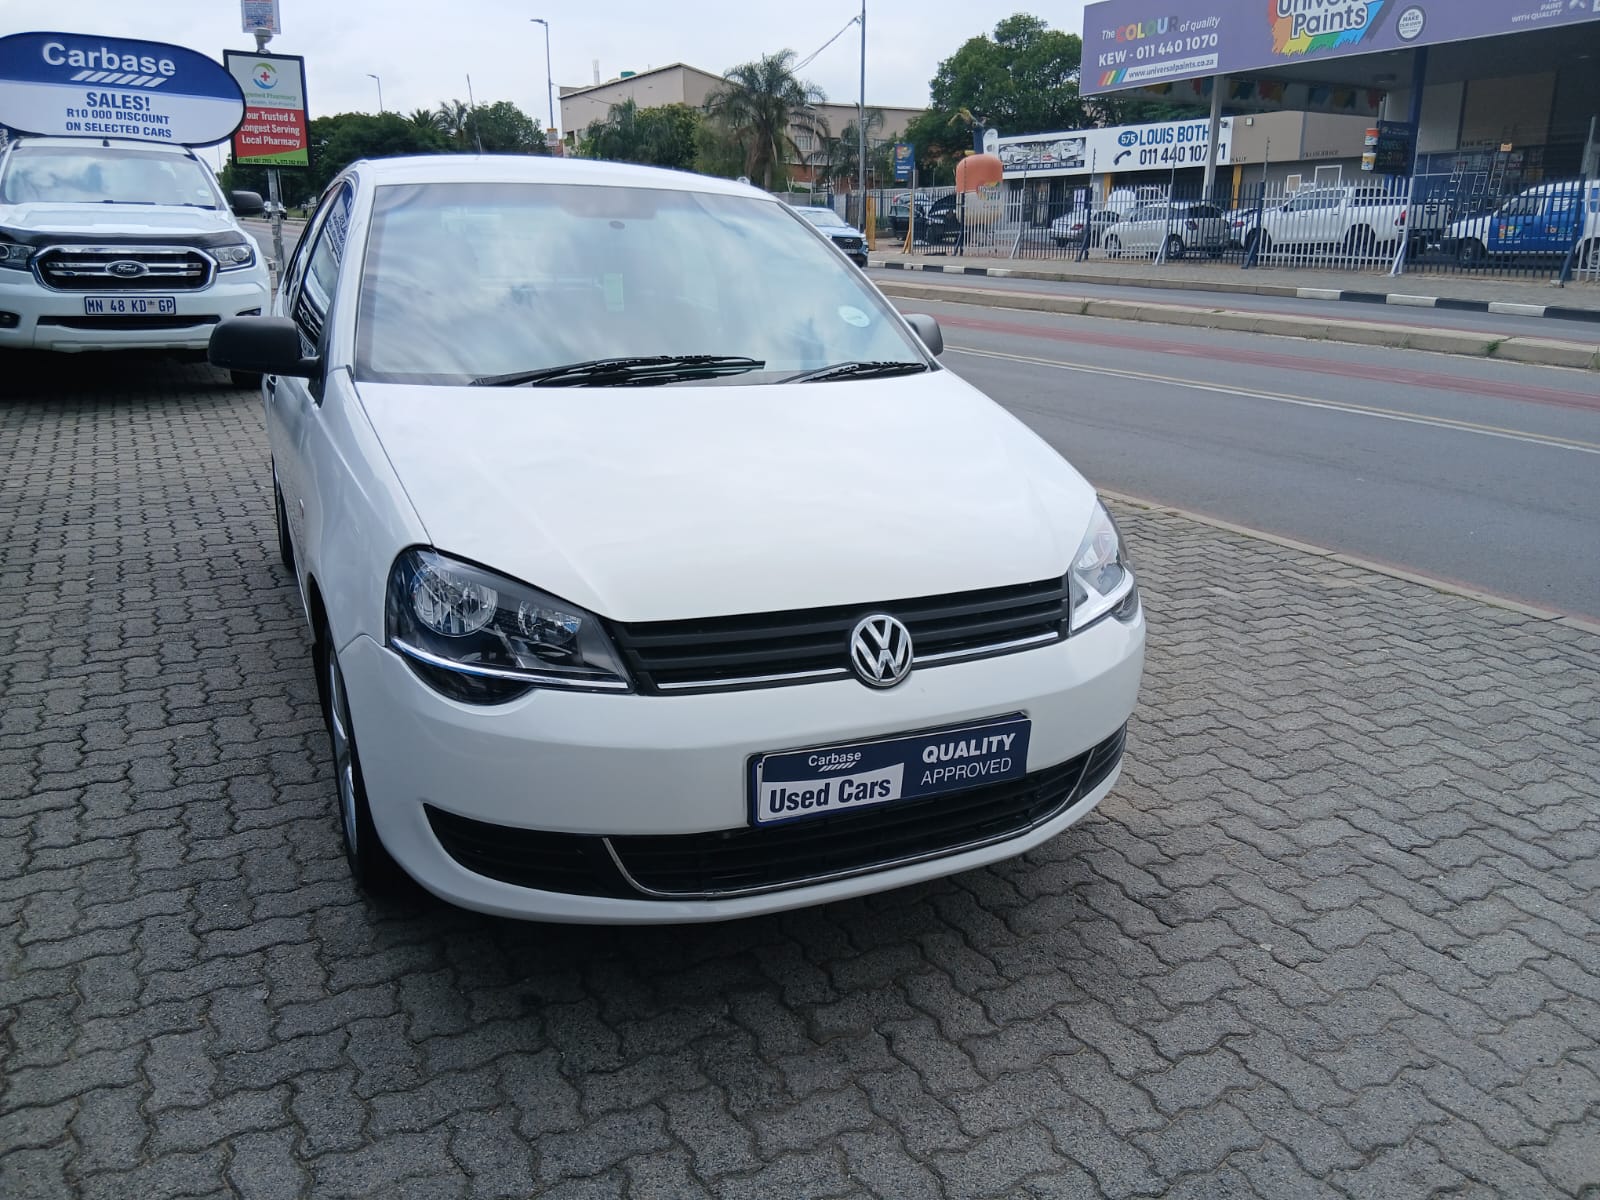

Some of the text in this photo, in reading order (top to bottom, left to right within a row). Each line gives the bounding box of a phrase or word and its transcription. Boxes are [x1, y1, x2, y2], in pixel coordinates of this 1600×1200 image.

[1293, 8, 1366, 36] Paints
[1511, 9, 1562, 22] WITH QUALITY
[1102, 16, 1220, 43] The COLOUR of quality
[42, 43, 176, 76] Carbase
[1098, 49, 1127, 67] KEW
[1136, 44, 1155, 60] 011
[1158, 40, 1183, 56] 440
[1186, 33, 1218, 50] 1070
[1128, 59, 1214, 78] www.universalpaints.co.za
[86, 92, 150, 111] SALES!
[67, 108, 170, 124] R10 000 DISCOUNT
[260, 112, 288, 121] Trusted
[290, 113, 296, 122] &
[66, 122, 172, 138] ON SELECTED CARS
[271, 125, 300, 136] Serving
[1121, 133, 1136, 145] 575
[1139, 127, 1174, 146] LOUIS
[242, 135, 300, 148] Local Pharmacy
[1140, 148, 1158, 165] 011
[1161, 146, 1186, 163] 440
[87, 300, 173, 312] MN 48 KD GP
[922, 733, 1016, 764] QUALITY
[808, 752, 862, 767] Carbase
[920, 757, 1012, 786] APPROVED
[769, 778, 891, 814] Used Cars
